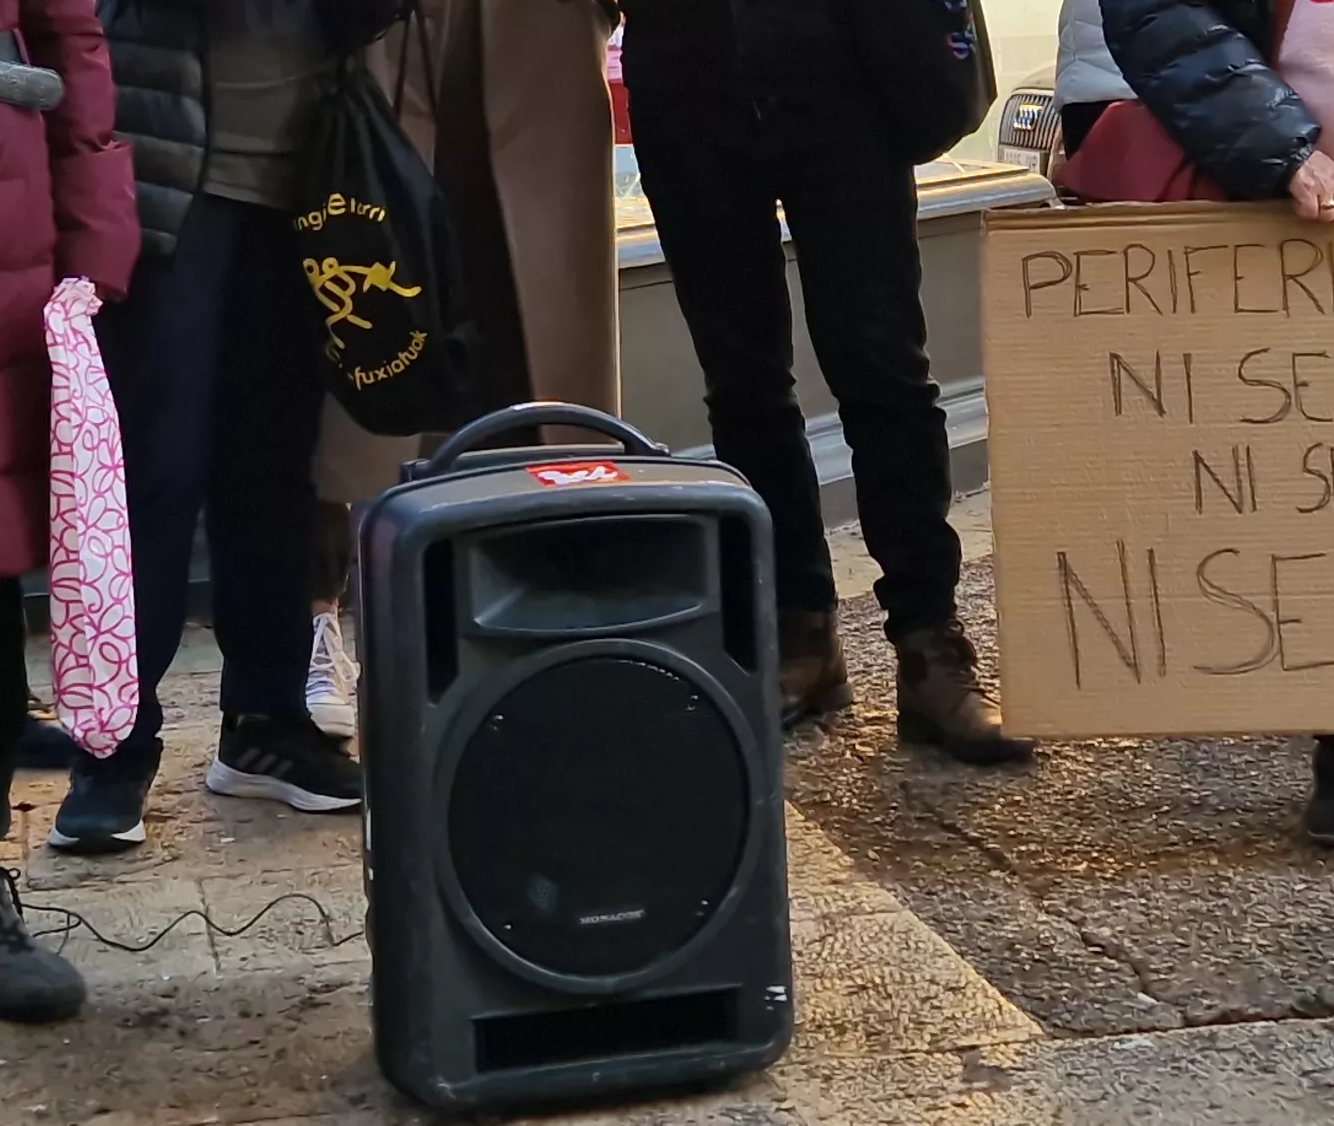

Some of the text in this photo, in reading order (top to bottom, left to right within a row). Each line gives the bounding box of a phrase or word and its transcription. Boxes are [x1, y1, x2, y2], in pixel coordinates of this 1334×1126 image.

[1109, 351, 1197, 425] NI
[1237, 348, 1334, 425] SE
[1192, 444, 1257, 514] NI
[1056, 539, 1168, 690] NI
